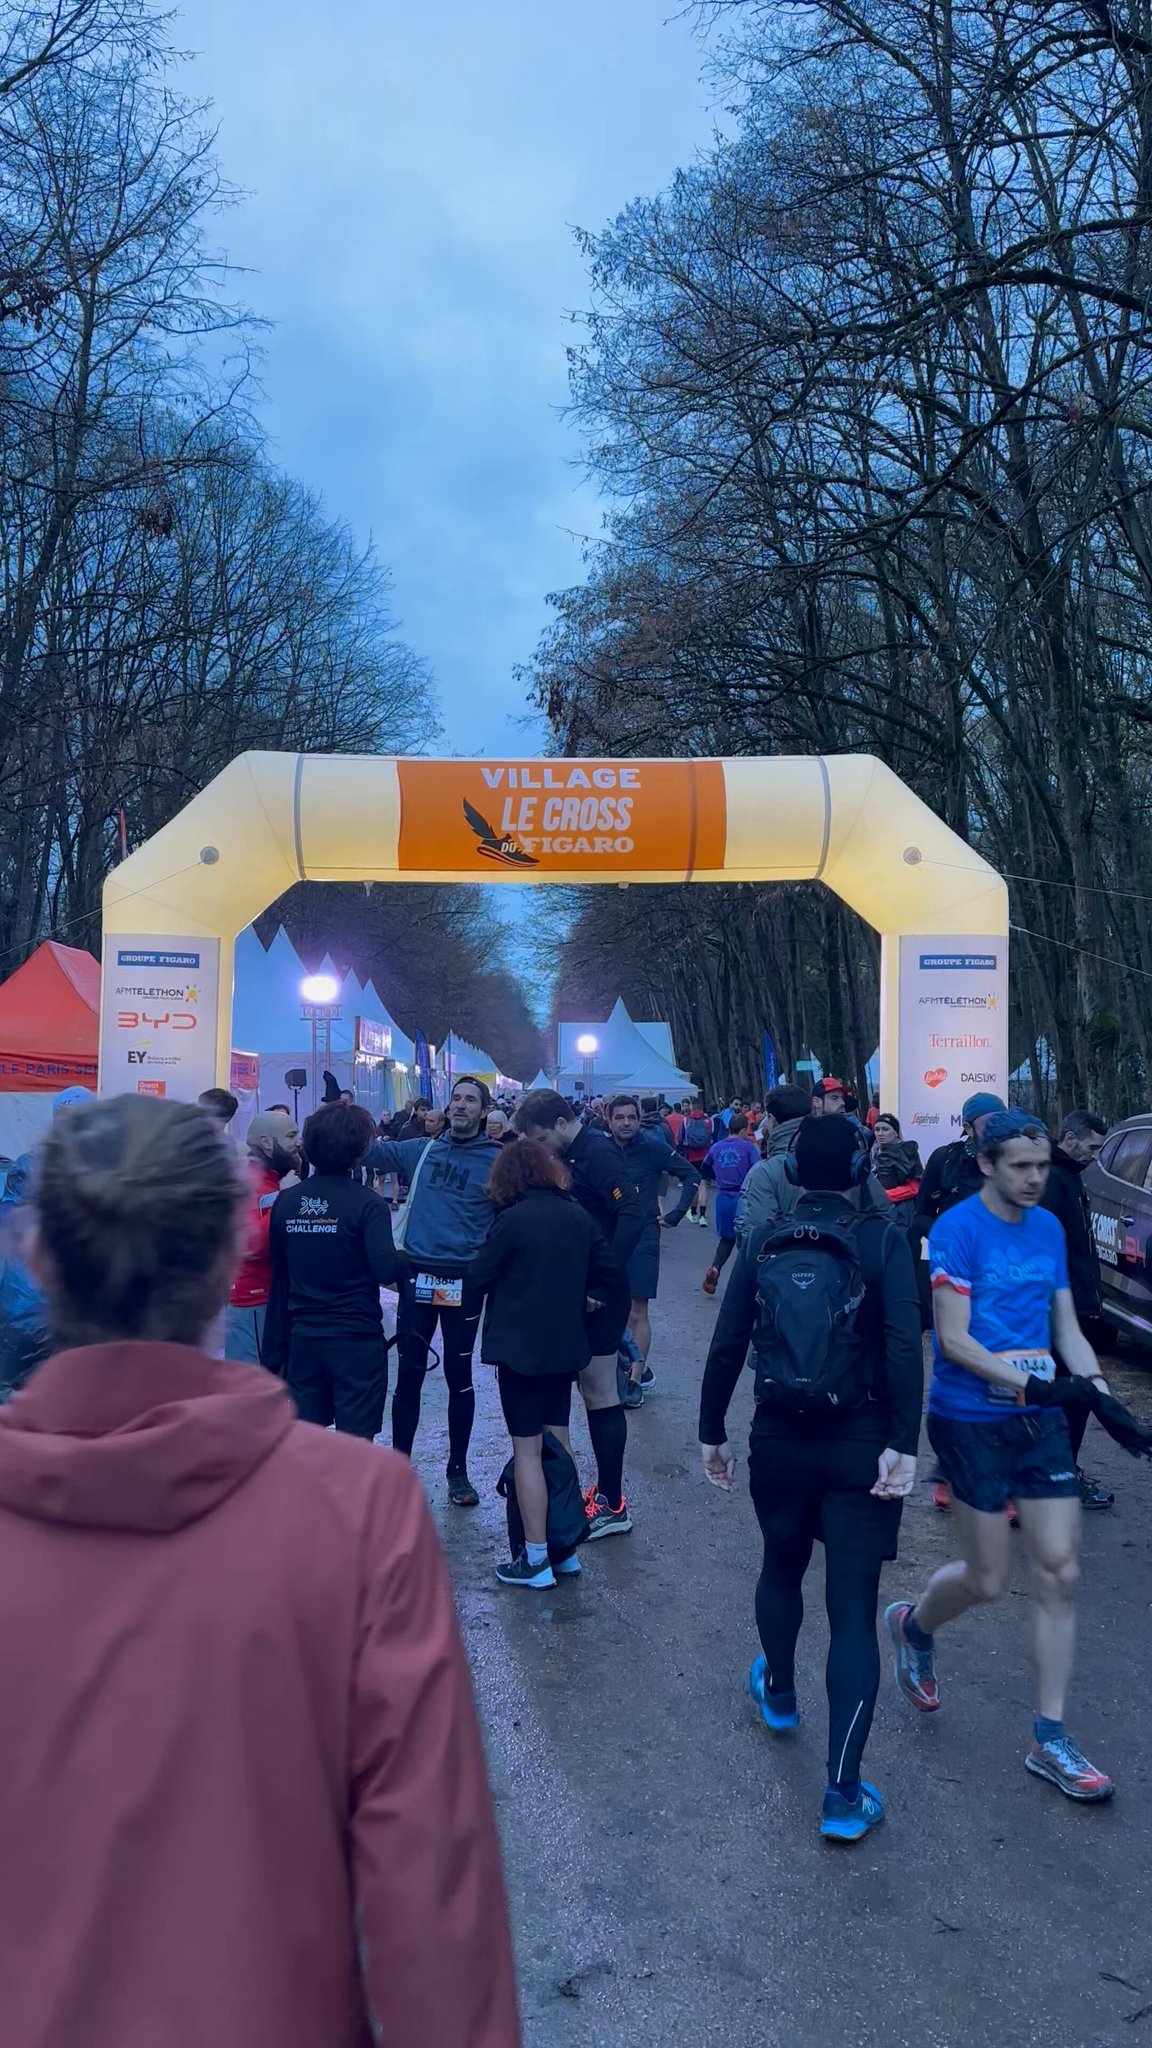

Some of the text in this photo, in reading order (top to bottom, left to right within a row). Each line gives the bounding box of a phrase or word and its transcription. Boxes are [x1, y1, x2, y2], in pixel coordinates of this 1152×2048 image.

[481, 768, 641, 788] VILLAGE
[501, 797, 634, 831] LE CROSS
[501, 836, 634, 853] DU FIGARO
[120, 955, 196, 965] GROUPE FIGARO
[117, 1012, 197, 1030] BYD
[929, 1033, 990, 1048] Terraillon
[127, 1051, 147, 1064] EY
[26, 1064, 69, 1074] PARIS
[960, 1073, 996, 1082] DAISUKI
[286, 1225, 338, 1233] CHALLENGE
